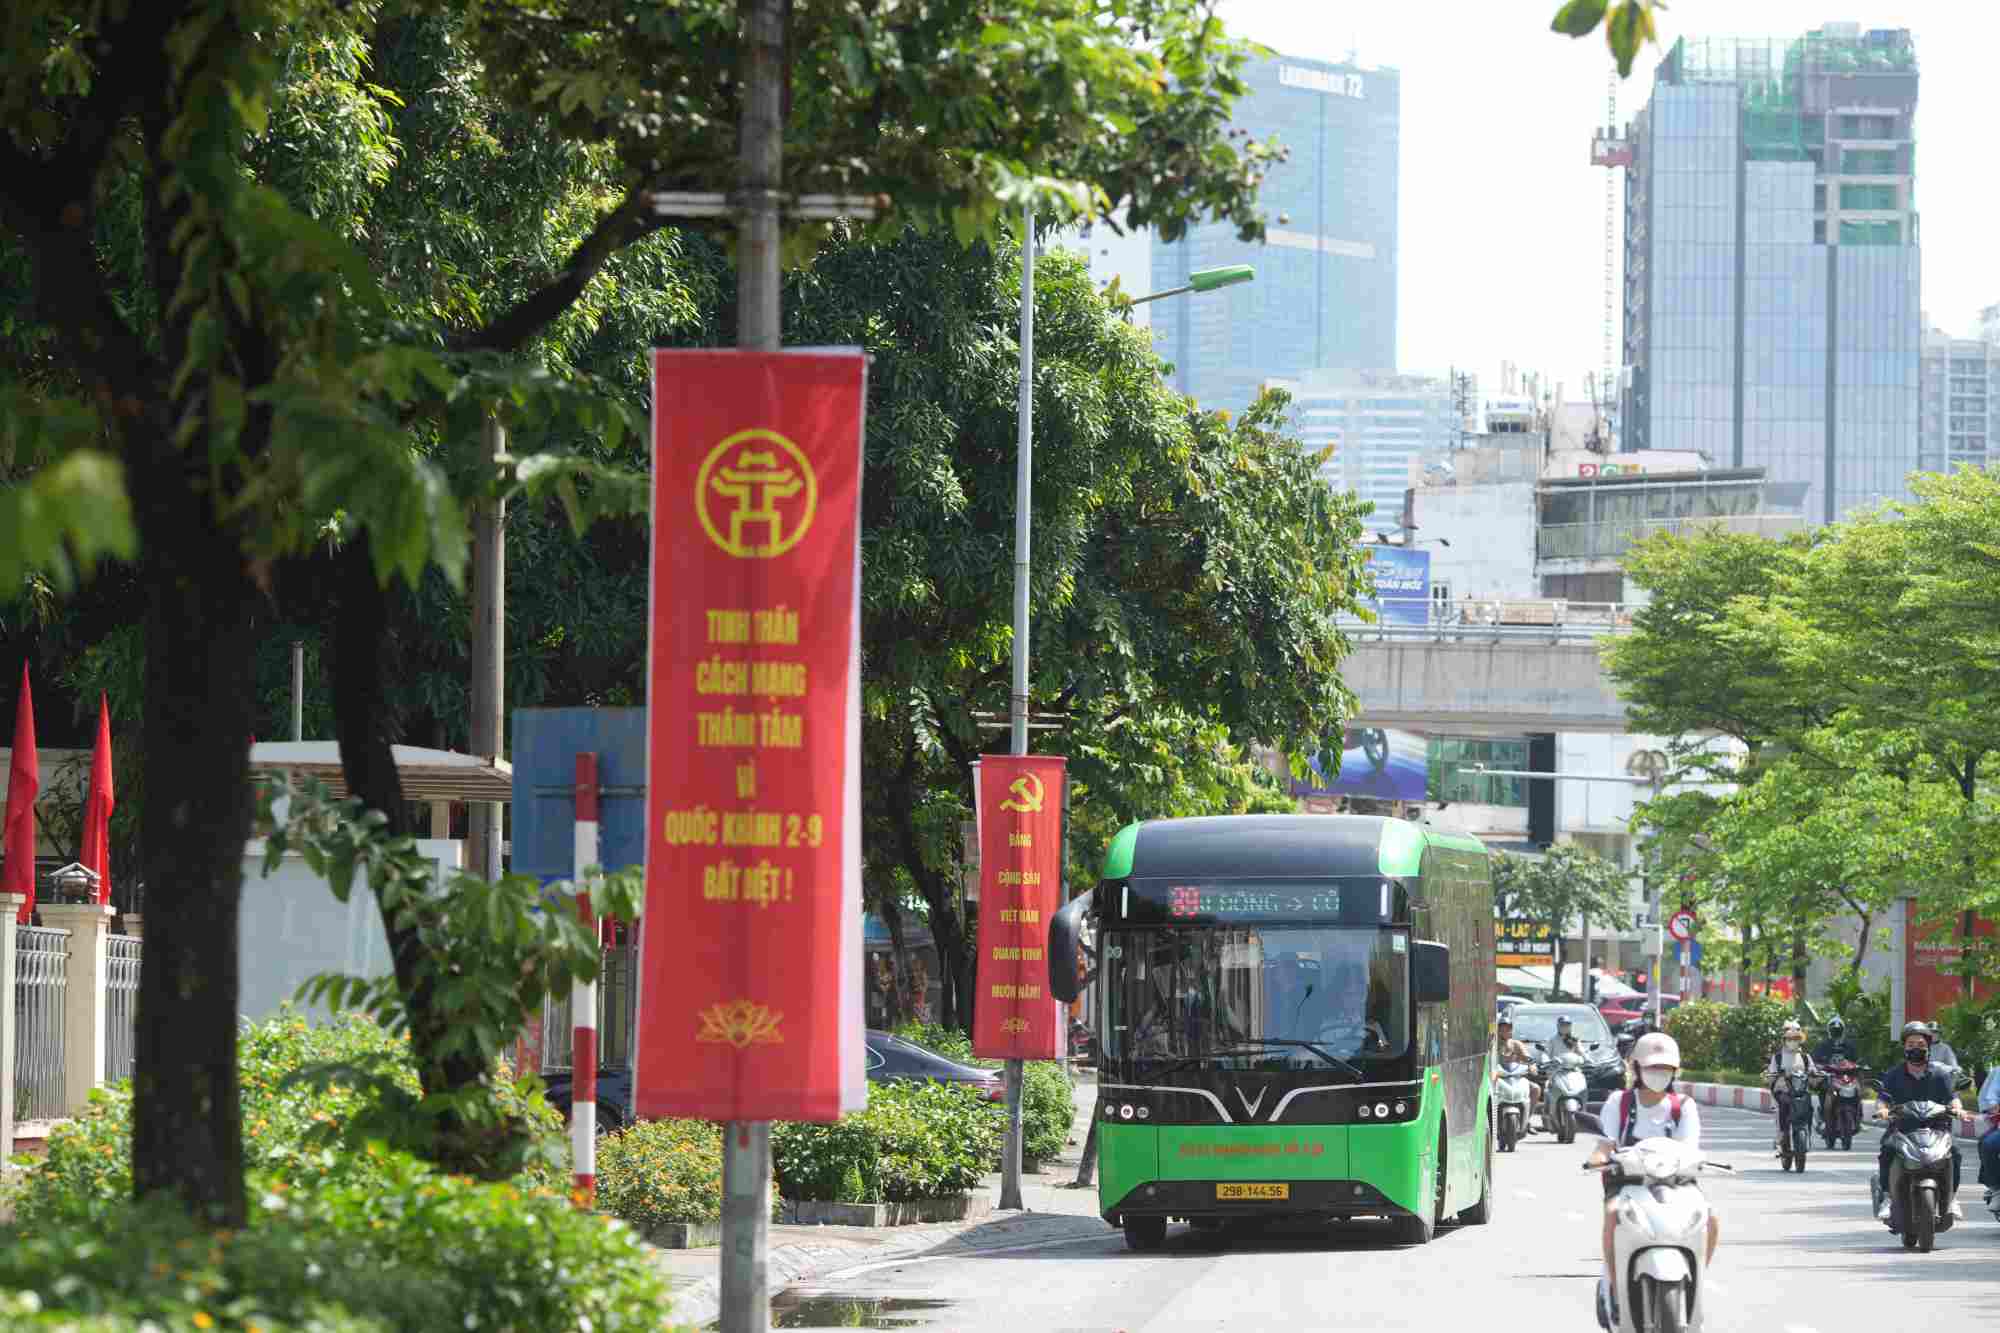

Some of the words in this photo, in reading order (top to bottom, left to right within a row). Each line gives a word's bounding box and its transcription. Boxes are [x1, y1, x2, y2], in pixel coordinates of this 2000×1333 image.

[696, 654, 747, 695] CÁCH
[760, 706, 802, 747] TÁM
[664, 805, 718, 846] QUỐC
[722, 806, 782, 846] KHÁNH
[786, 814, 824, 848] 2-9
